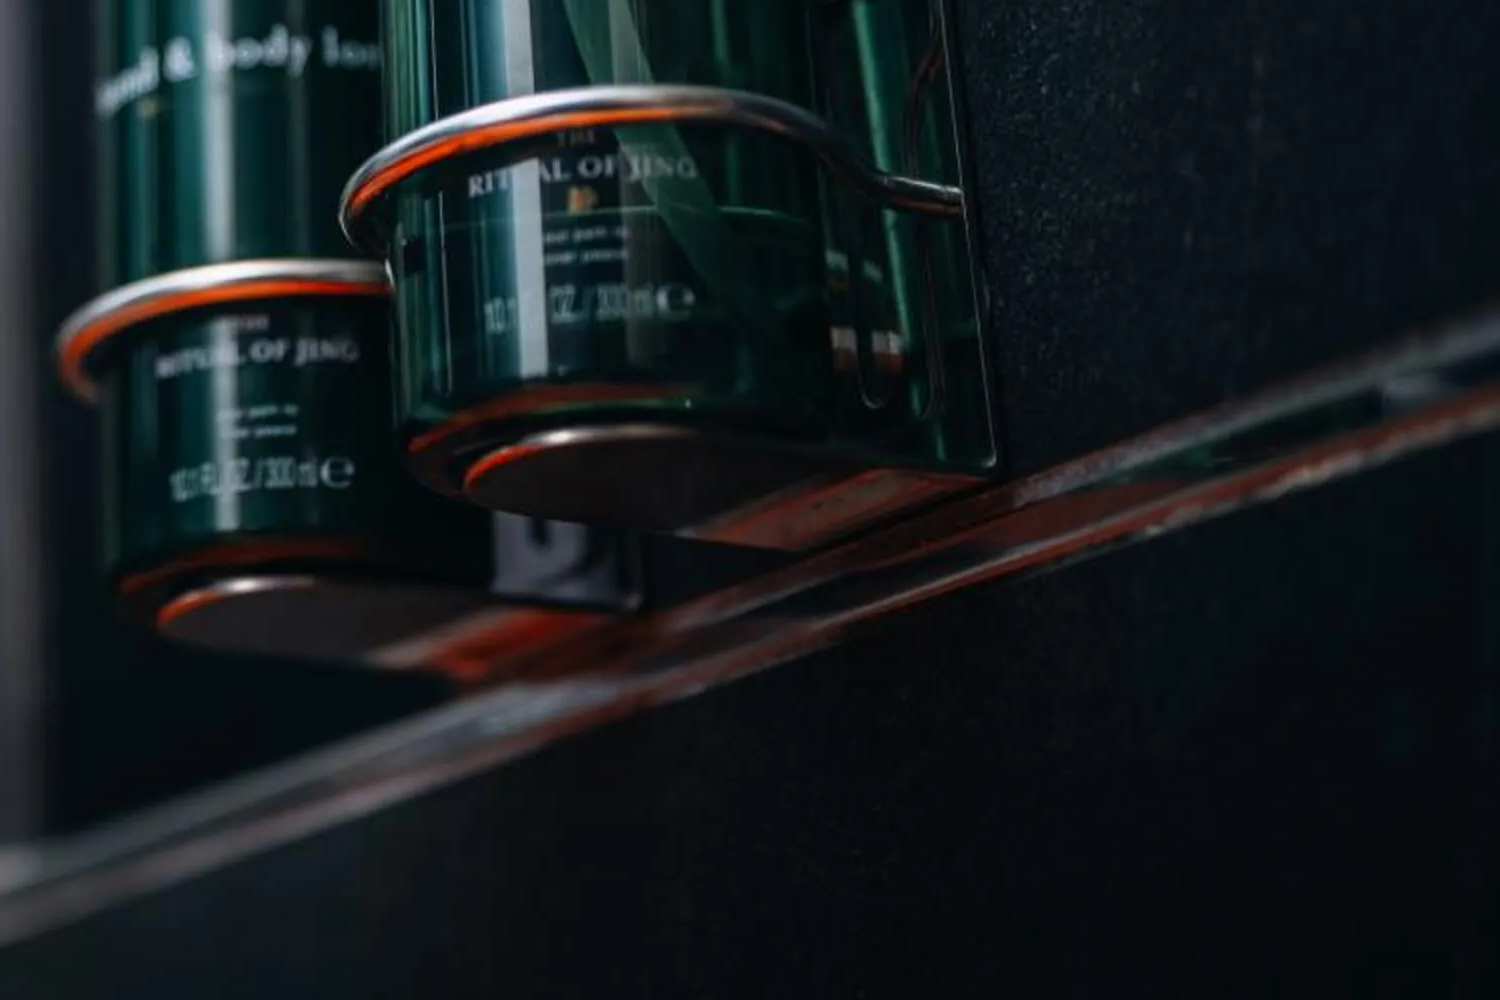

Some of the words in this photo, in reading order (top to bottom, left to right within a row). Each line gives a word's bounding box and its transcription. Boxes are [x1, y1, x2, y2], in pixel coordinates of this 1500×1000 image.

[205, 22, 313, 79] body
[467, 157, 571, 199] RITAL
[627, 153, 699, 182] JING
[249, 336, 291, 363] OF
[293, 335, 362, 368] JING
